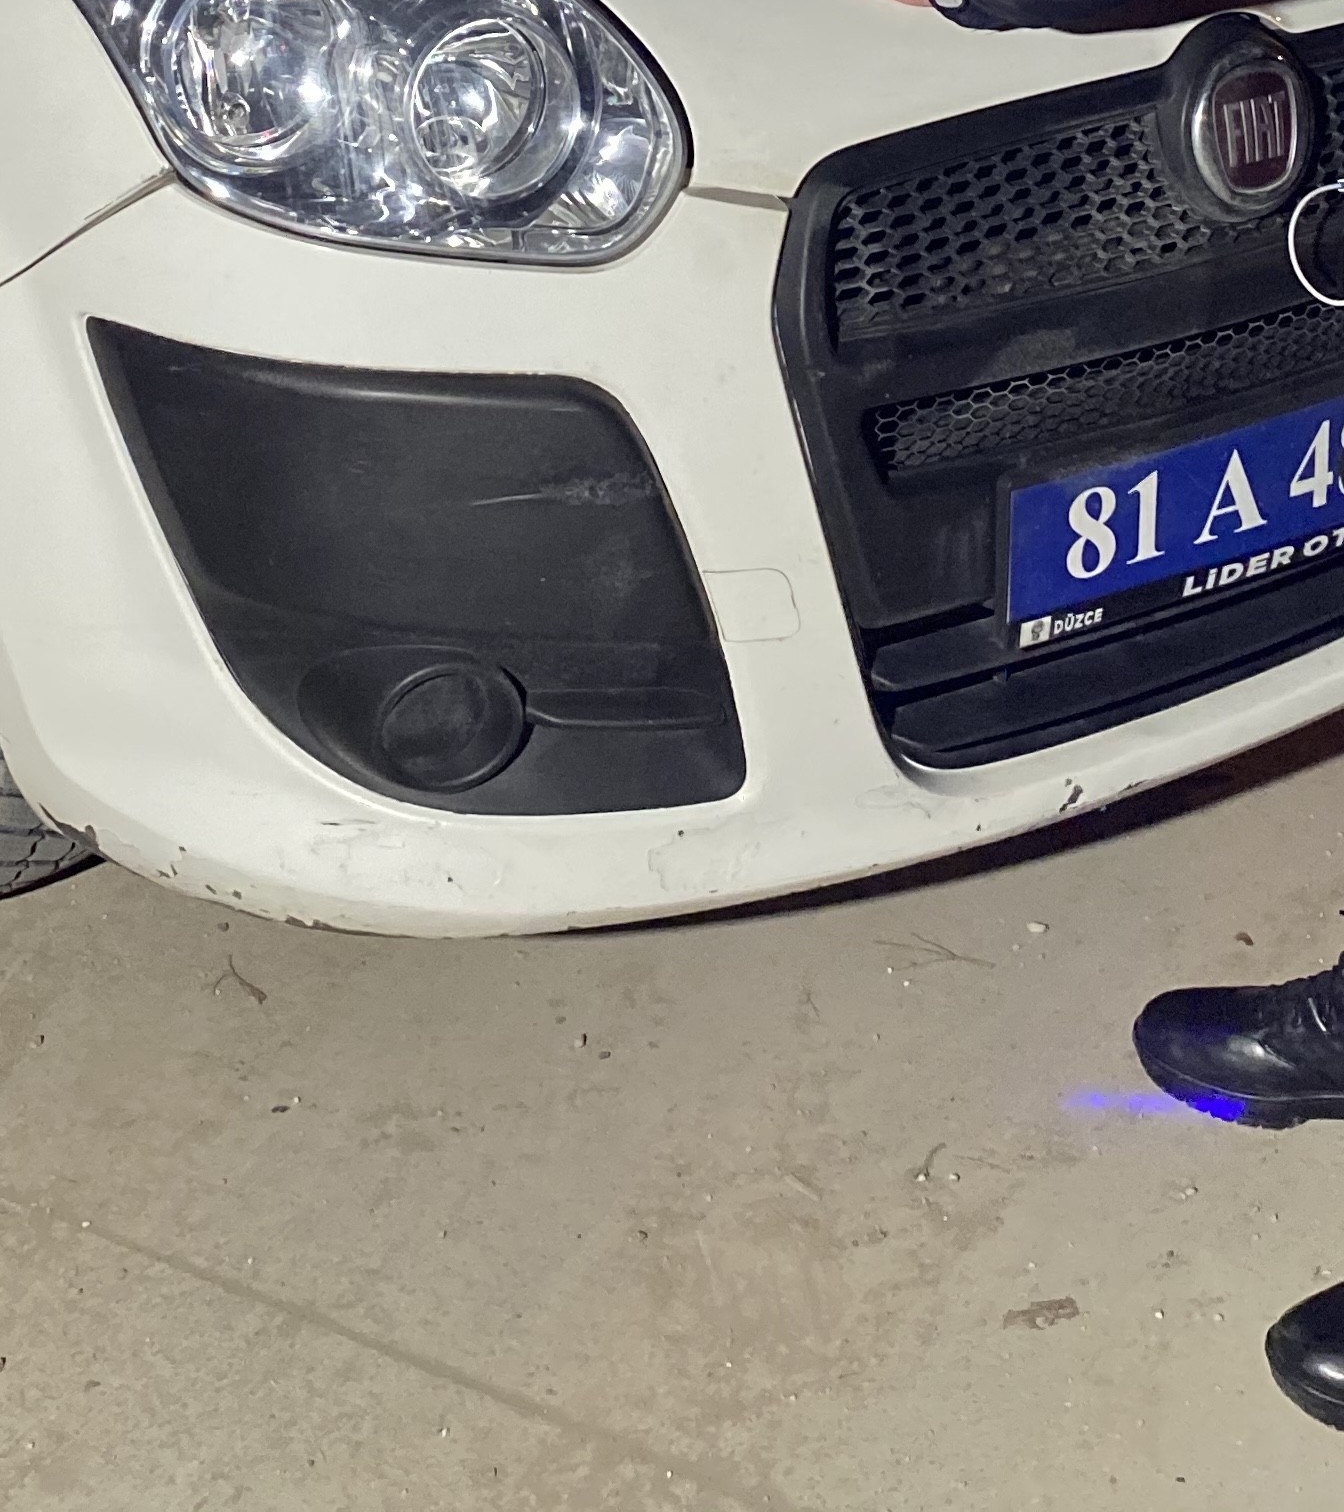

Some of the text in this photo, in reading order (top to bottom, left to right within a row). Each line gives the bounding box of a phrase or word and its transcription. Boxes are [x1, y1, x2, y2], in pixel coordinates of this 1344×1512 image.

[1223, 90, 1285, 168] FIAT
[1066, 470, 1166, 579] 81
[1193, 448, 1268, 545] A
[1053, 608, 1104, 635] DÜZCE
